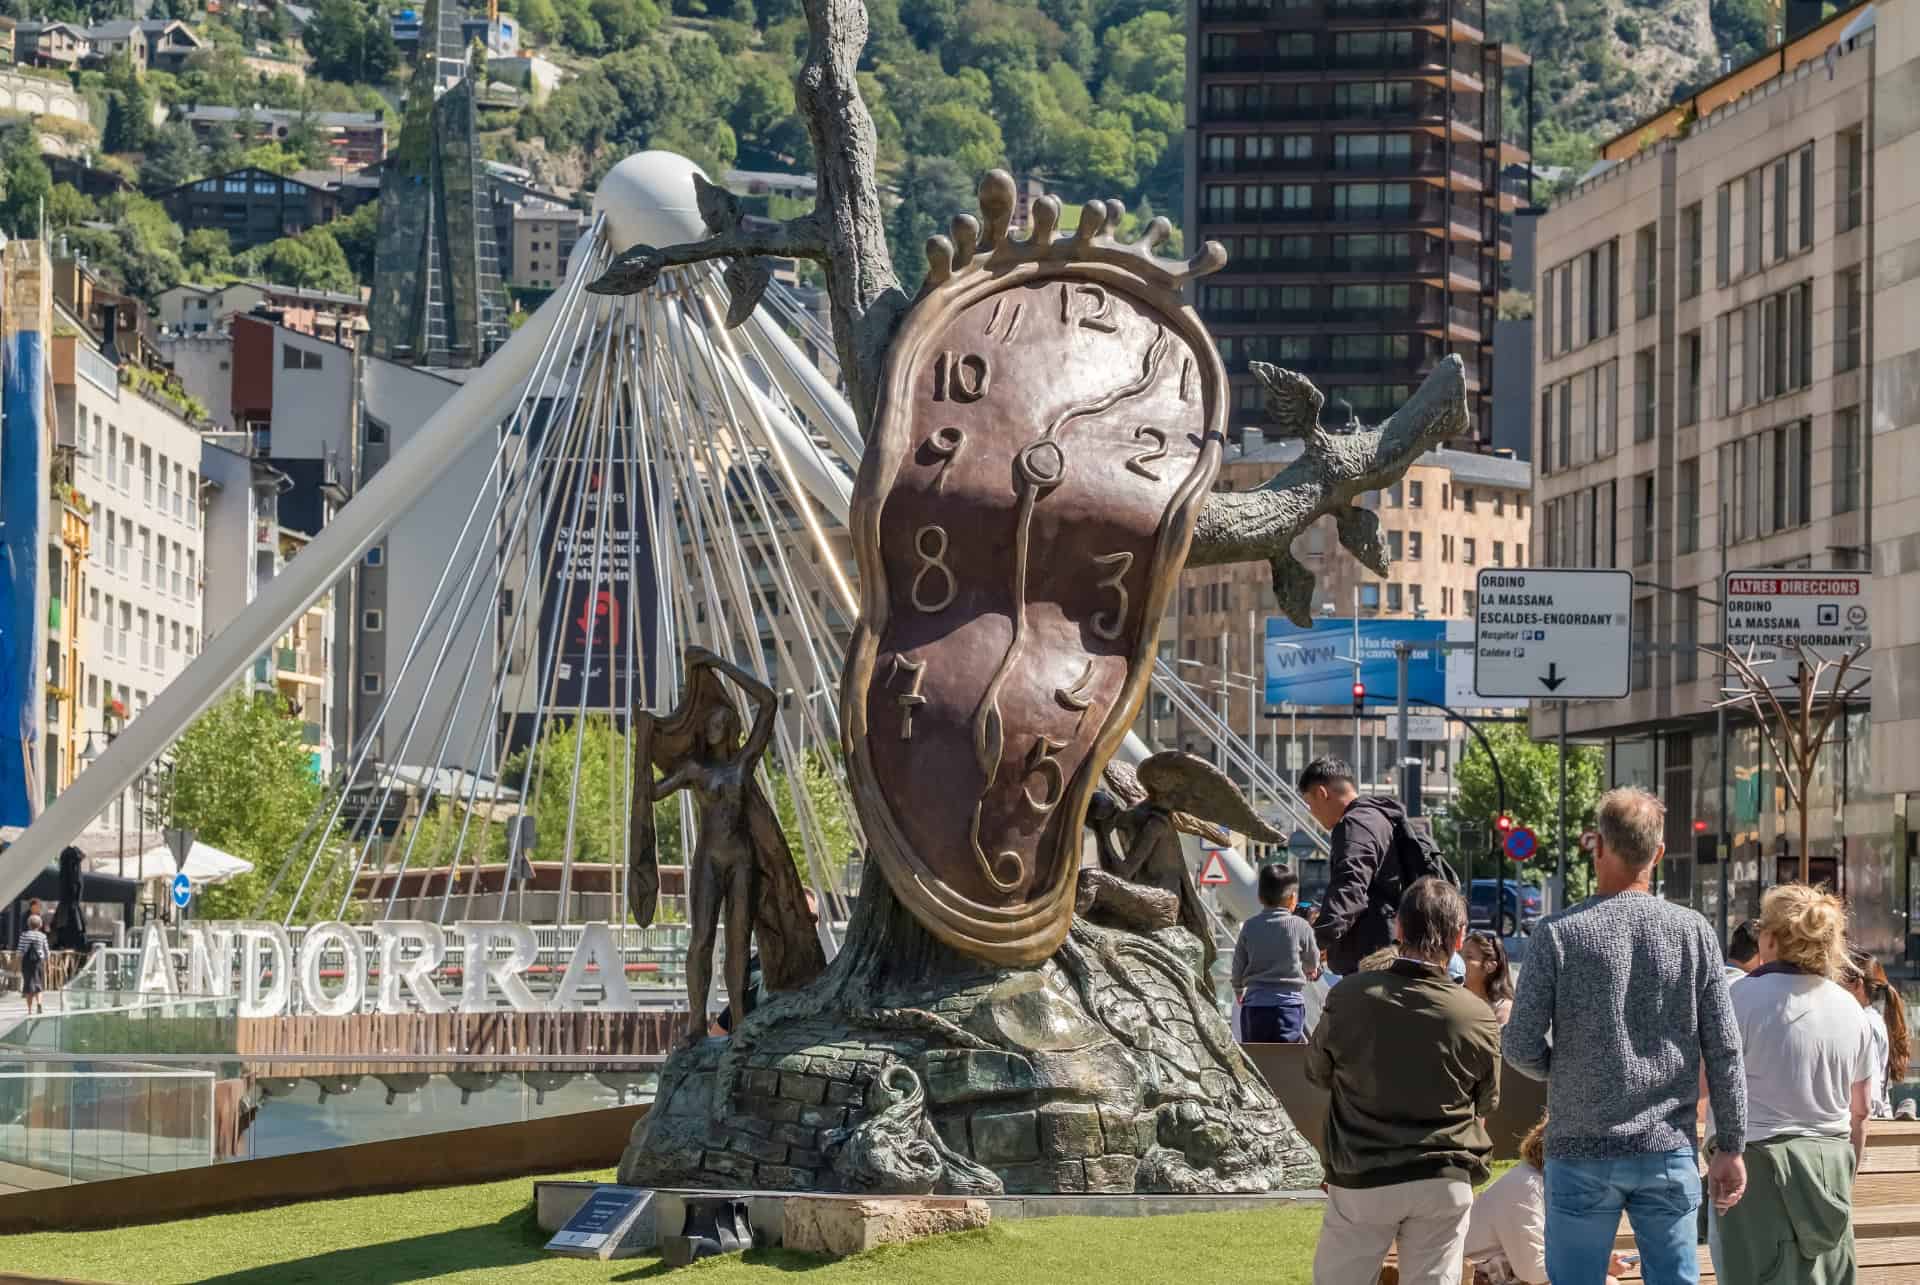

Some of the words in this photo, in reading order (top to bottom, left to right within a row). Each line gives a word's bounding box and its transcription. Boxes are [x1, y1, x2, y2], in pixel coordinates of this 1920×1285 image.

[984, 297, 1023, 344] 11
[1060, 283, 1117, 333] 12
[933, 351, 991, 403] 10
[1180, 357, 1193, 401] 1
[929, 426, 967, 495] 9
[1126, 425, 1168, 482] 2
[912, 525, 954, 613] 8
[1481, 576, 1526, 588] ORDINO
[1731, 581, 1777, 593] ALTRES
[1780, 581, 1857, 594] DIRECCIONS
[1089, 551, 1135, 641] 3
[1480, 612, 1612, 625] ESCALDES-ENGORDANY
[1481, 594, 1495, 606] LA
[1499, 594, 1553, 606] MASSANA
[1728, 601, 1772, 612] ORDINO
[1728, 618, 1742, 629] LA
[1746, 617, 1800, 629] MASSANA
[886, 653, 927, 740] 7
[1023, 735, 1071, 813] 5
[972, 798, 1025, 892] 6
[130, 919, 640, 1018] ANDORRA
